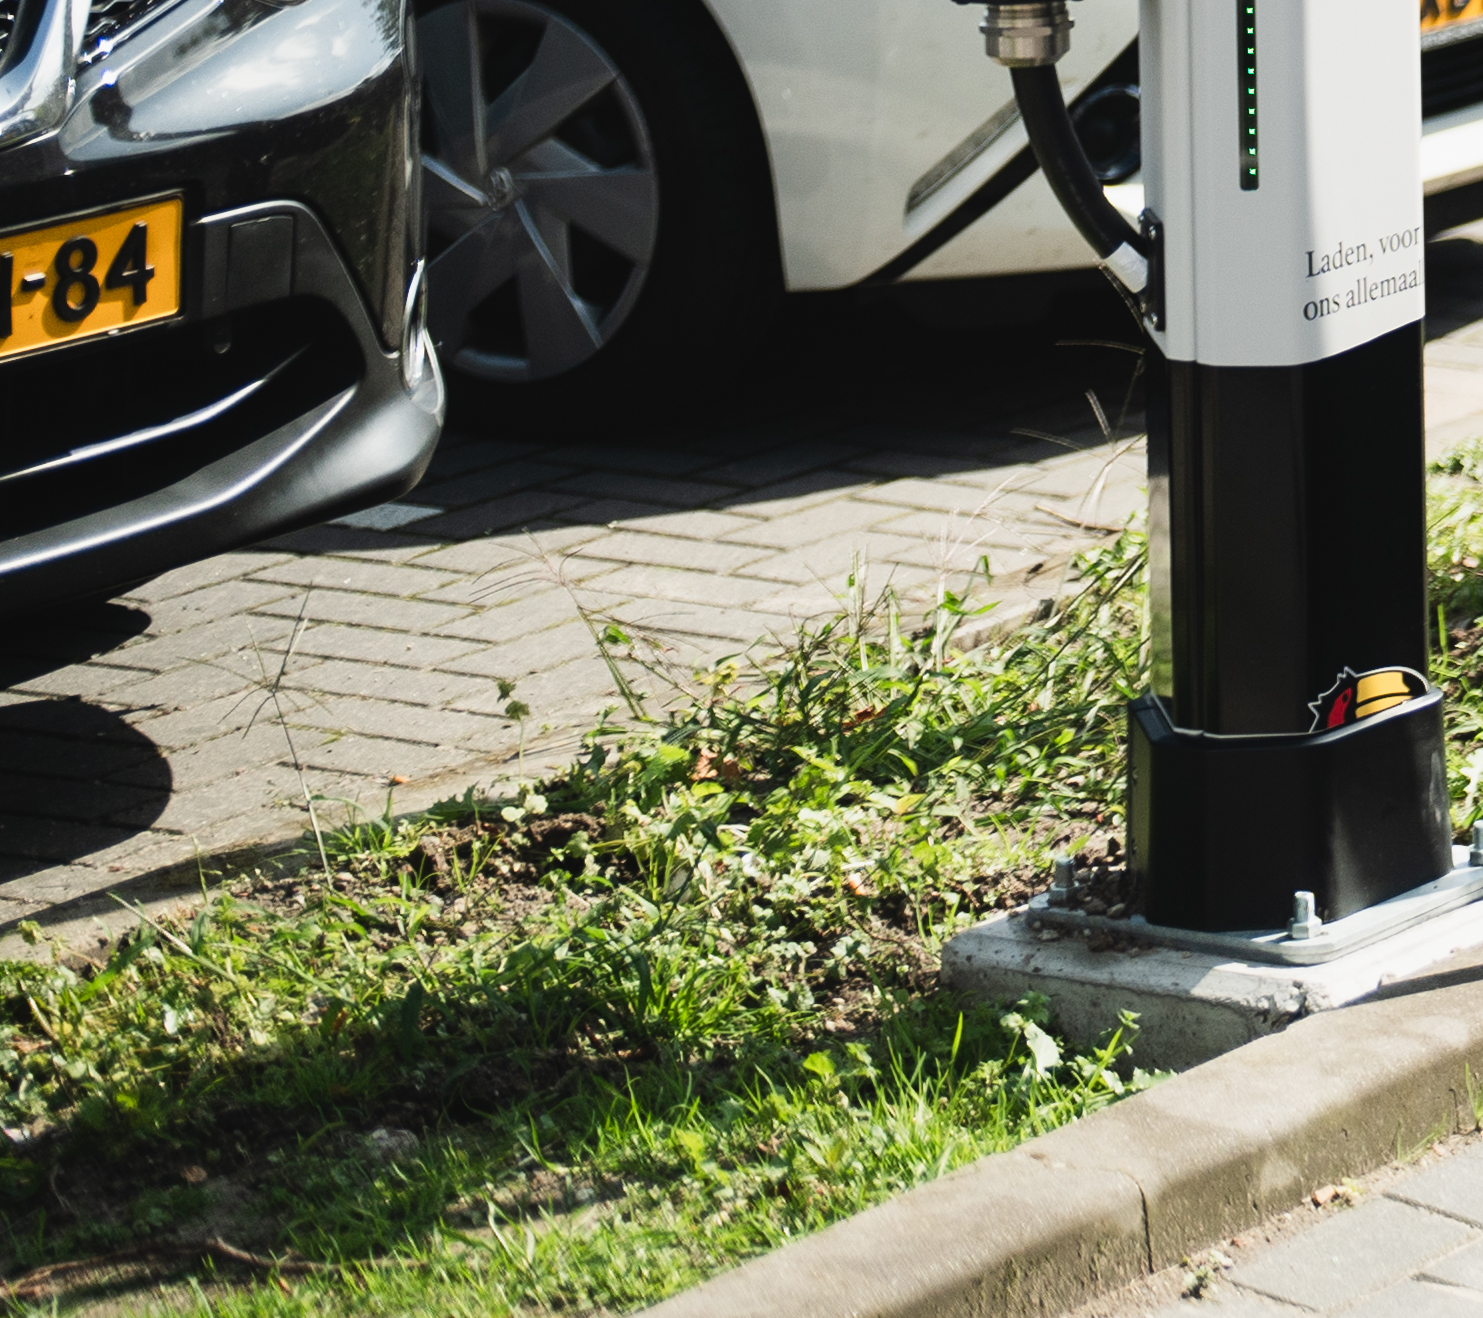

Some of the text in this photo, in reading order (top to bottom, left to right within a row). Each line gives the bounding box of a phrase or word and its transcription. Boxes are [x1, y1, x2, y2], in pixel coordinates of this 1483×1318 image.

[1305, 227, 1420, 278] Laden, voor
[1303, 293, 1340, 321] ons
